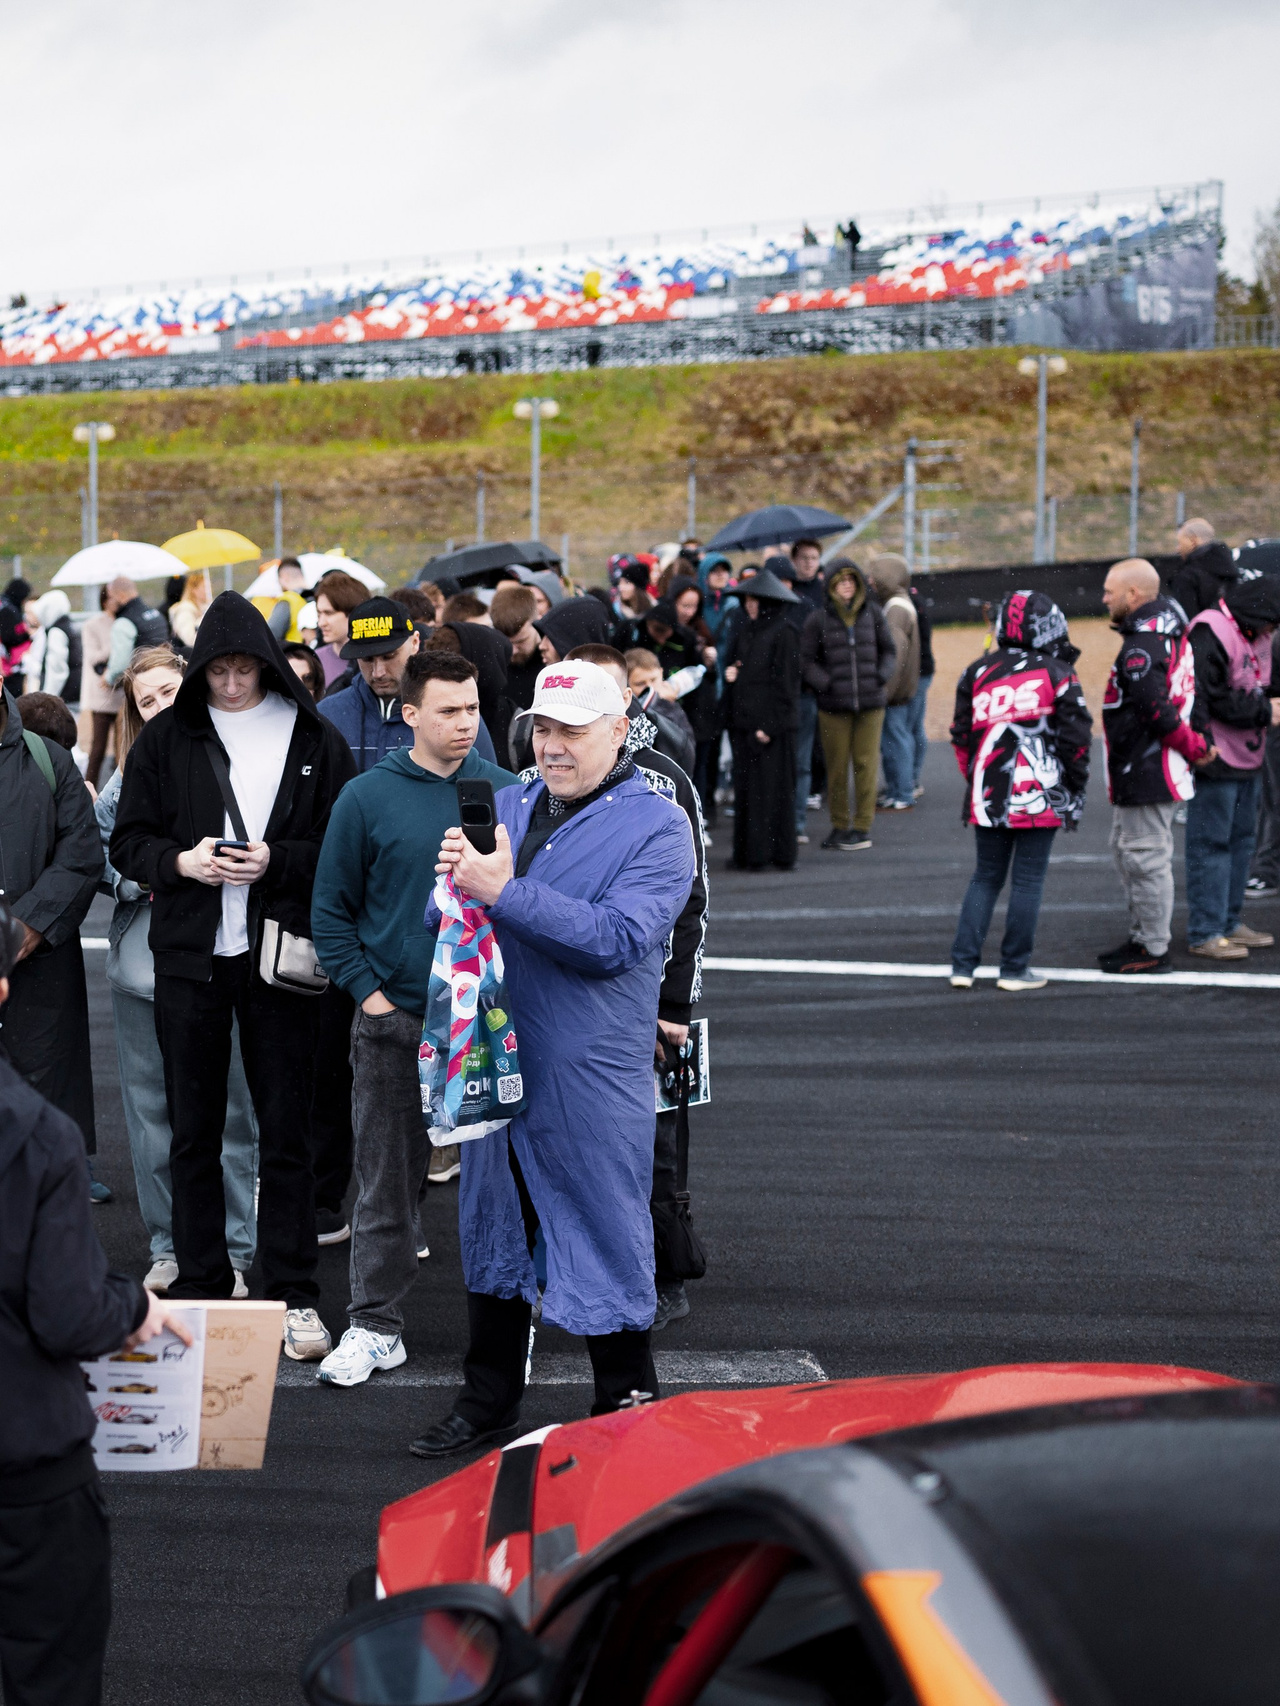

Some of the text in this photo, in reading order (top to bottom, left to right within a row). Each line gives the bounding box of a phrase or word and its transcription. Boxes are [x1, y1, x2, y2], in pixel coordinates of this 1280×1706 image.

[351, 616, 393, 632] SIBERIAN
[541, 675, 580, 689] RDS
[972, 679, 1044, 724] RDS
